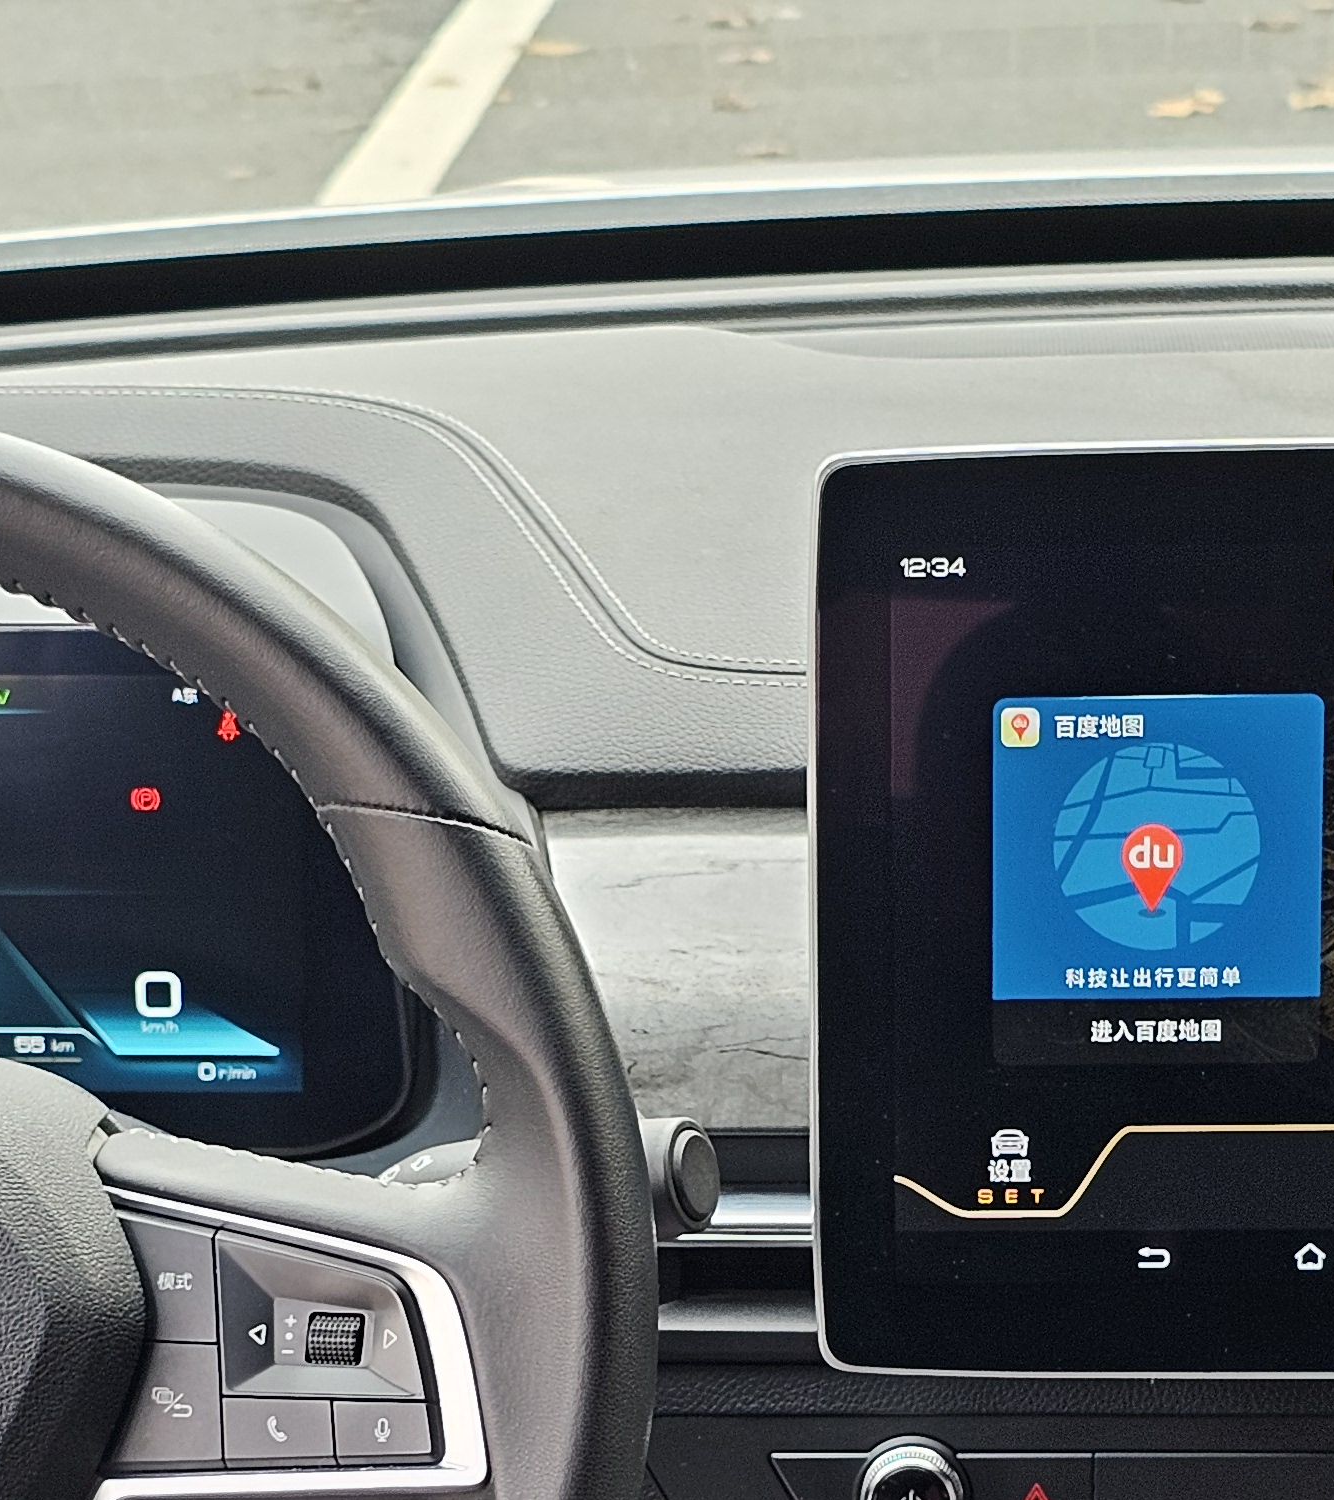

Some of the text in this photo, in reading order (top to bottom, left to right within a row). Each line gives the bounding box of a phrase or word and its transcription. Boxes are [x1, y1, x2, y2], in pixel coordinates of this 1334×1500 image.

[900, 556, 966, 578] 12:34
[1053, 713, 1145, 739] 百度地图
[1128, 835, 1175, 869] du
[1064, 965, 1242, 990] 科技让出行更简单
[134, 970, 183, 1018] 0
[1089, 1018, 1223, 1044] 进入百度地图
[197, 1061, 216, 1082] 0
[987, 1159, 1033, 1184] 设置
[977, 1187, 1045, 1204] SET
[157, 1271, 194, 1292] 模式
